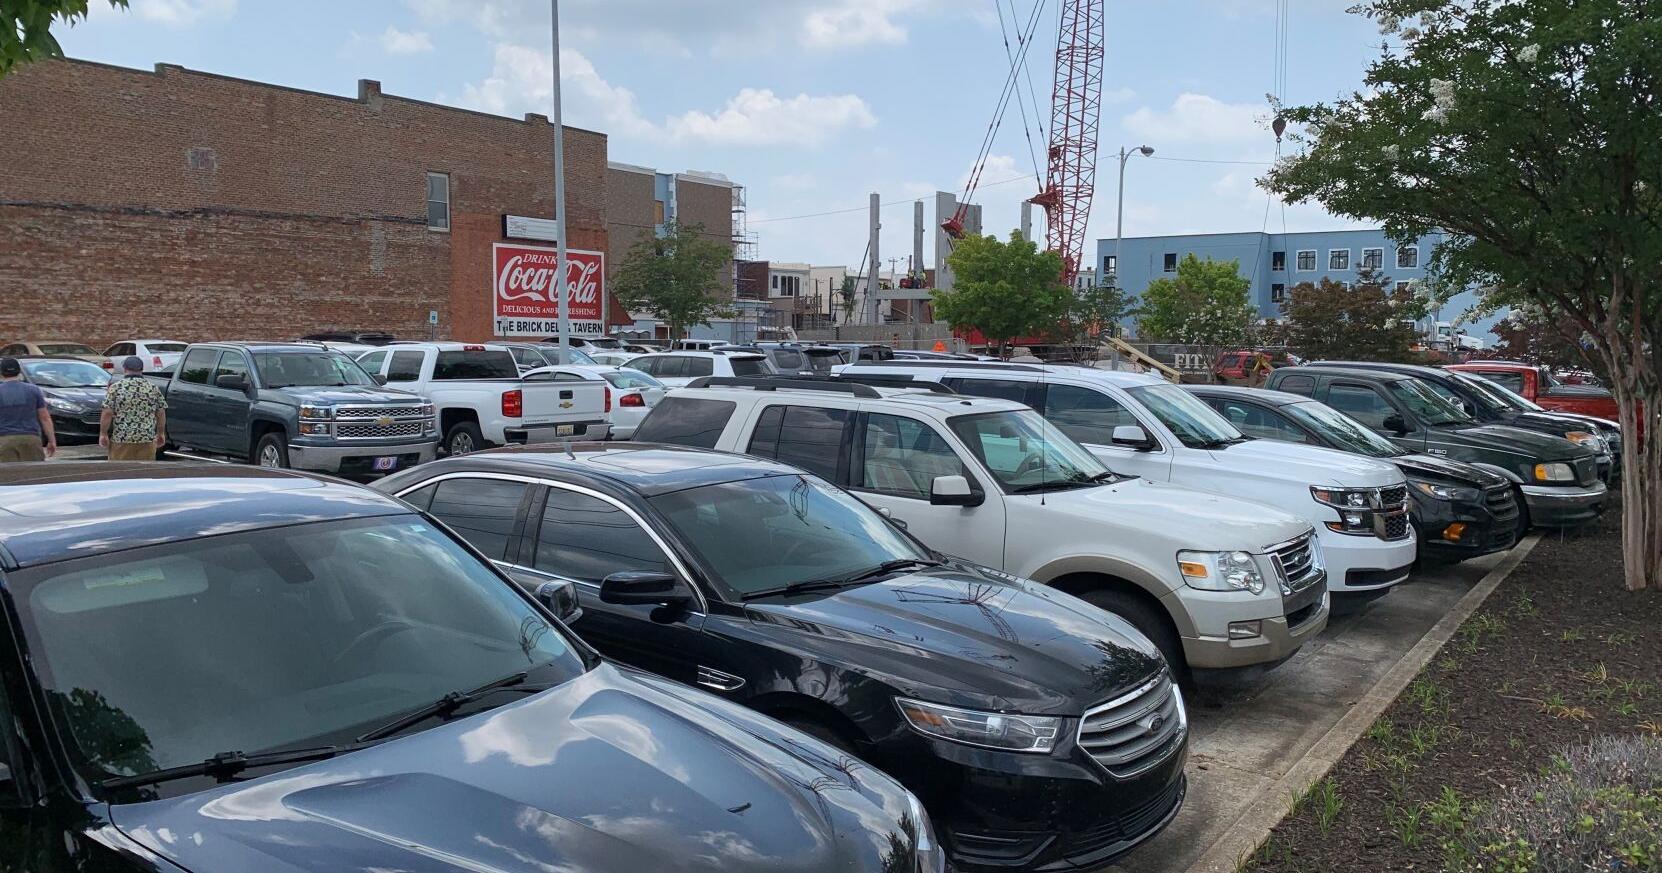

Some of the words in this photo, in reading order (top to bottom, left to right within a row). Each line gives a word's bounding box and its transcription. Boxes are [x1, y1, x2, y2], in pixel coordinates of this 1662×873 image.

[523, 253, 559, 265] DRINK
[499, 255, 600, 304] Coca-Cola
[502, 304, 541, 314] DELICIOUS
[555, 307, 596, 316] RRESHING
[516, 321, 543, 333] BRICK
[545, 322, 562, 333] DEL
[573, 322, 603, 333] TAVERN
